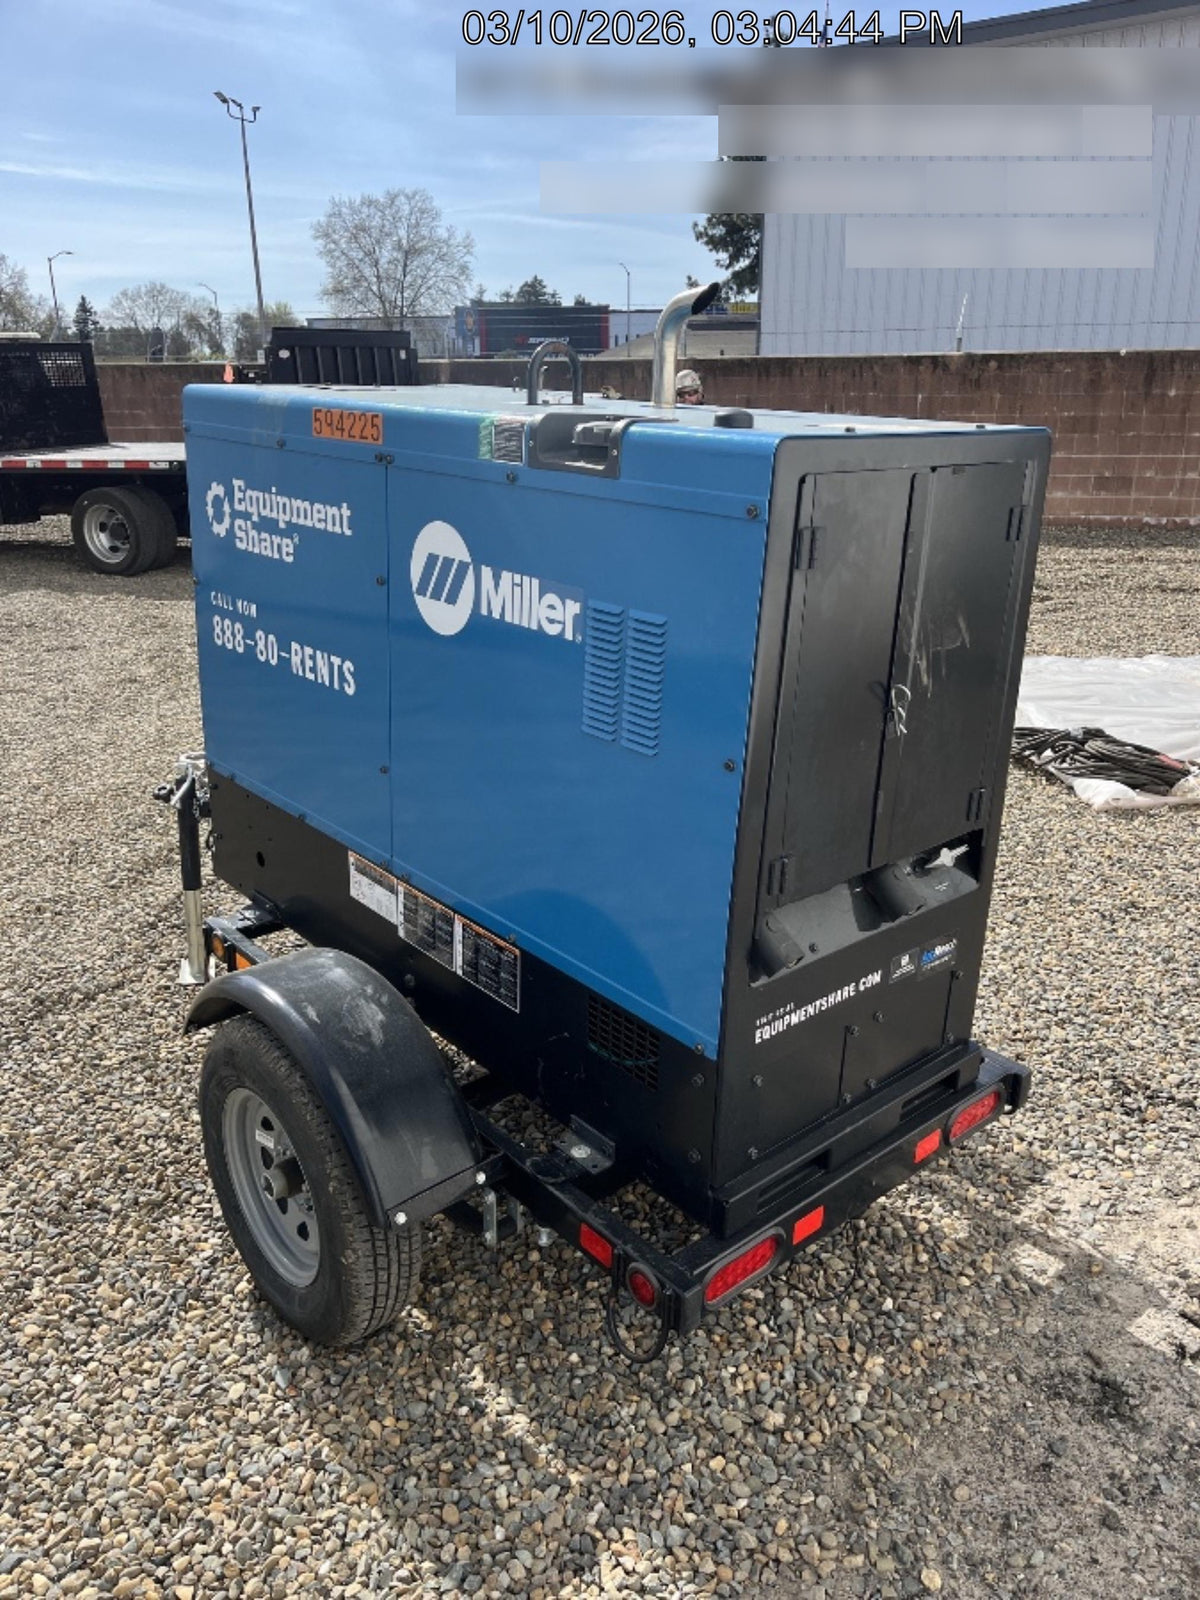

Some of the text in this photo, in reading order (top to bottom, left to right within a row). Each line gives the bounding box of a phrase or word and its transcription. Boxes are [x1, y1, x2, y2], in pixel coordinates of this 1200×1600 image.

[313, 408, 381, 441] 594225
[232, 478, 352, 536] Equipment
[211, 591, 257, 618] CALL NOW
[213, 614, 356, 696] 888-80-RENTS
